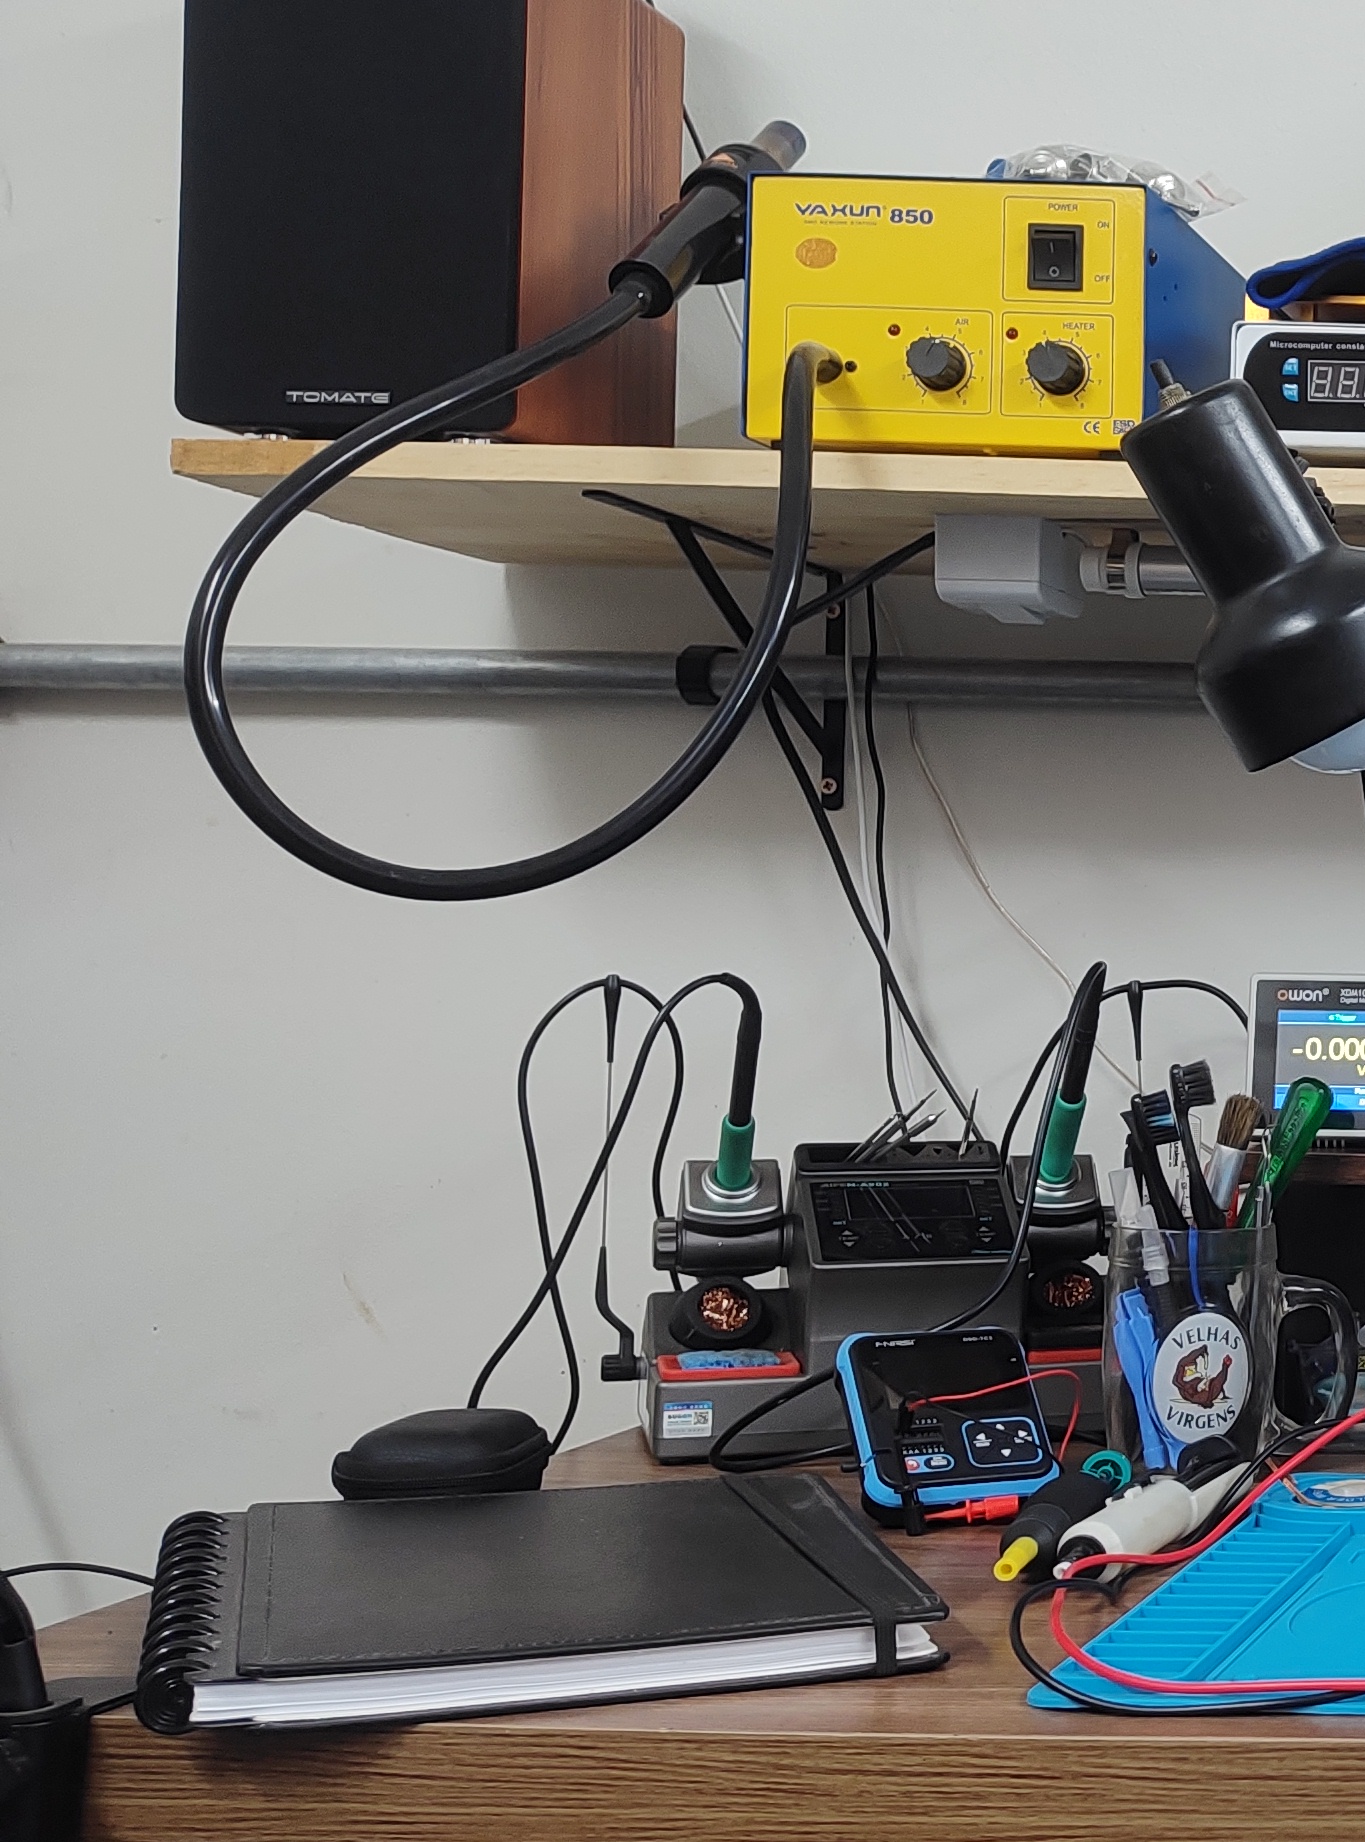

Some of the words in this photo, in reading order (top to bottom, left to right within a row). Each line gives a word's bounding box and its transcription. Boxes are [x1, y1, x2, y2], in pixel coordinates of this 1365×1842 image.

[1048, 203, 1078, 212] POWER
[890, 208, 934, 225] 850
[1097, 221, 1110, 229] ON
[1094, 274, 1110, 282] OFF
[955, 318, 969, 326] AIR
[1062, 322, 1095, 331] HEATER
[1269, 340, 1333, 351] Microcomputer
[286, 391, 390, 404] TOMATE
[1172, 1326, 1242, 1351] VELHAS
[1165, 1405, 1237, 1430] VIRGENS
